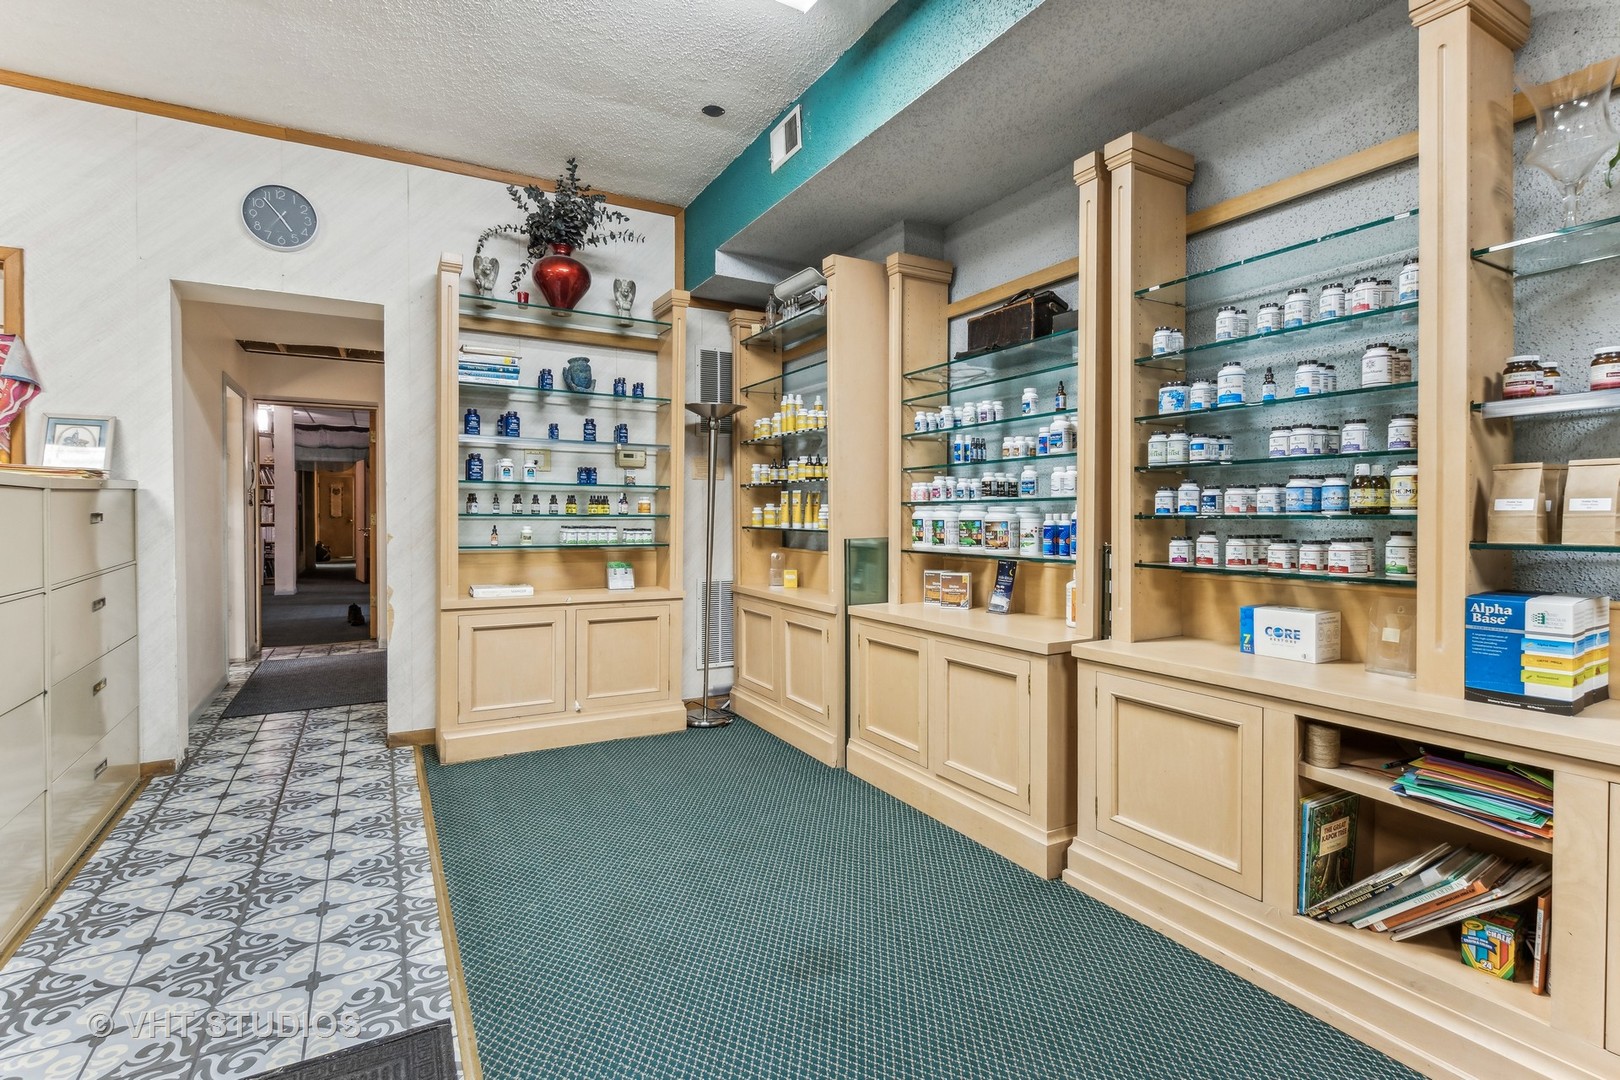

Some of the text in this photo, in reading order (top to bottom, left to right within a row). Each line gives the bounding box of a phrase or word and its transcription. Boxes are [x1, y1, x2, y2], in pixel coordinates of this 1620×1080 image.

[264, 190, 271, 201] 11
[275, 190, 286, 200] 12
[252, 198, 265, 208] 10
[249, 209, 258, 218] 9
[300, 205, 308, 215] 2
[254, 221, 261, 230] 8
[304, 217, 312, 226] 3
[264, 230, 272, 240] 7
[301, 228, 308, 236] 4
[278, 236, 286, 245] 6
[291, 234, 299, 243] 5
[1470, 602, 1513, 616] Alpha
[1472, 613, 1506, 625] Base
[1265, 626, 1300, 640] CORE
[1243, 634, 1251, 644] 7
[1324, 820, 1347, 835] THE GREAT
[1487, 930, 1513, 945] CHALK
[1481, 961, 1493, 970] 24
